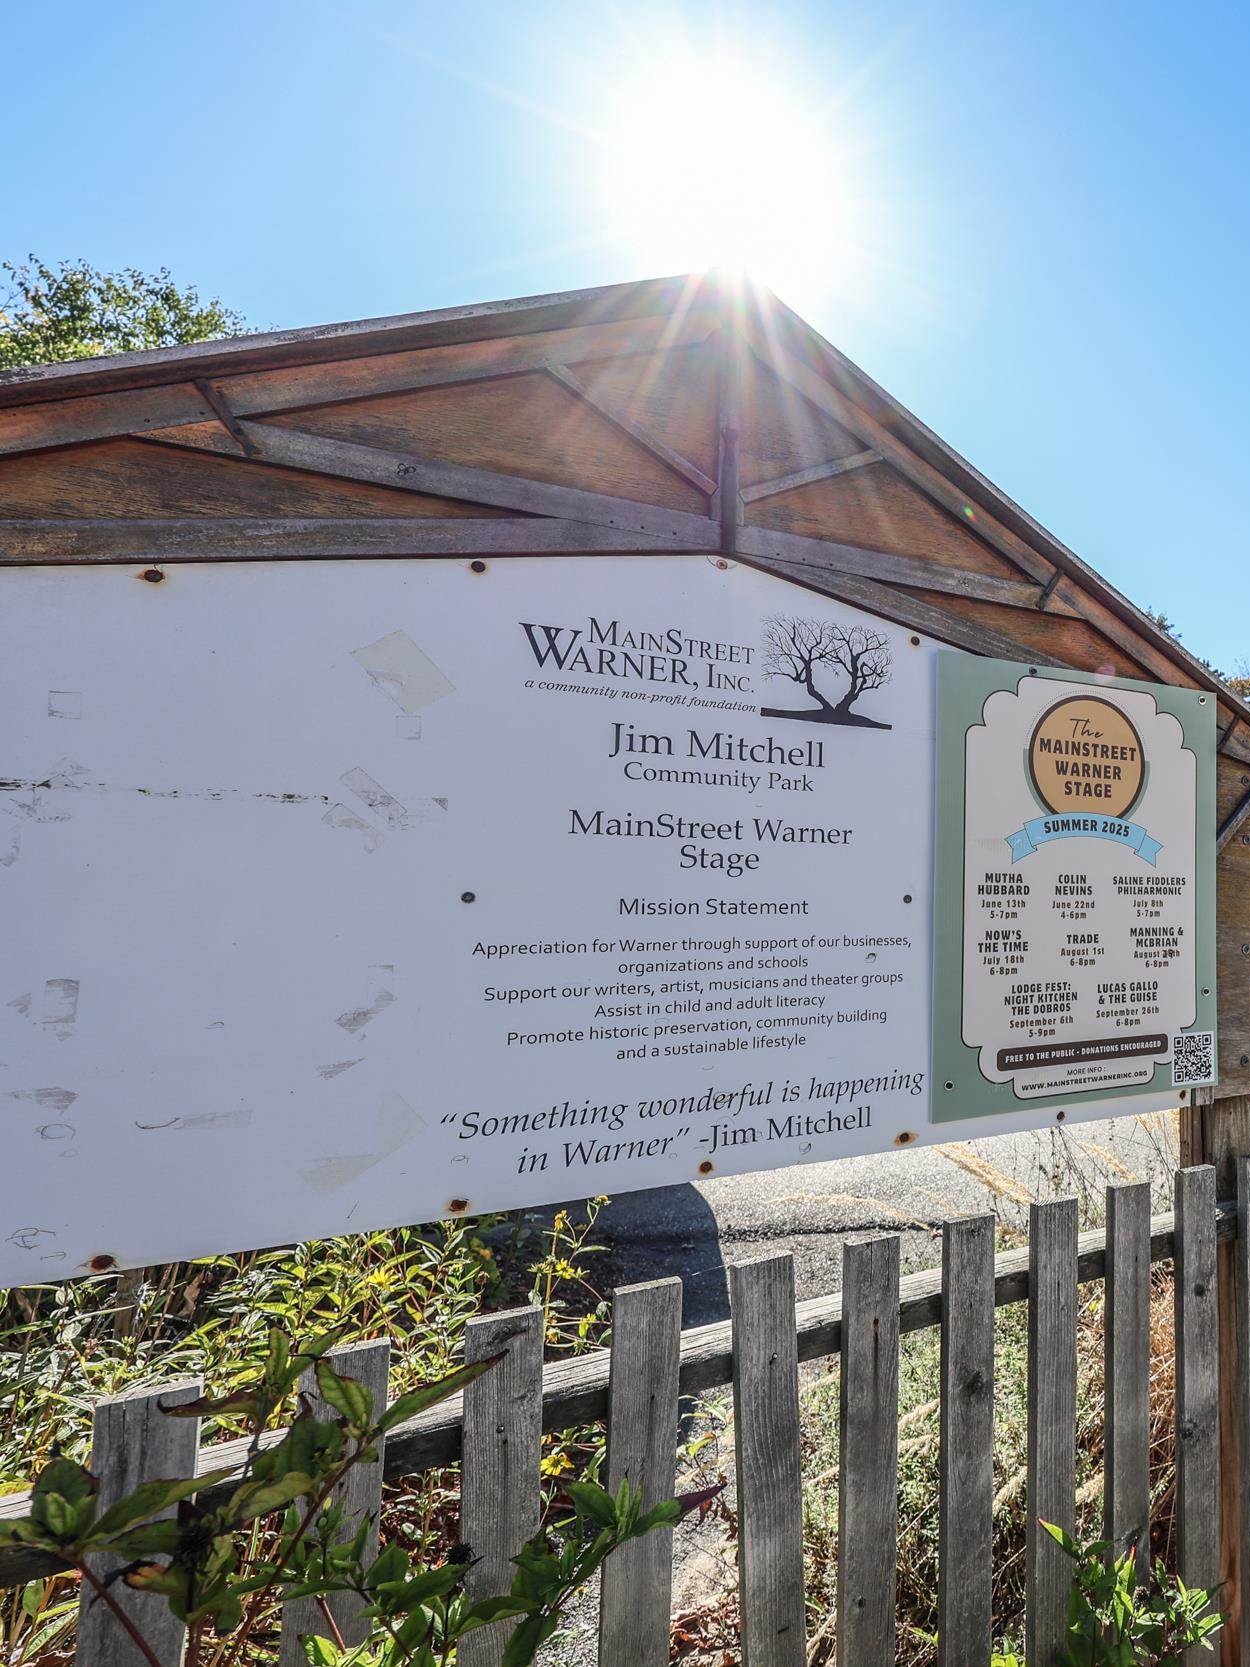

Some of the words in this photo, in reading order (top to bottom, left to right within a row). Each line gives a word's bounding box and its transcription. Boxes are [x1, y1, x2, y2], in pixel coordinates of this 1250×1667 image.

[525, 680, 534, 688] a
[538, 682, 618, 699] community
[622, 691, 686, 705] non-profit
[687, 697, 756, 712] foundation
[1070, 718, 1103, 739] The
[609, 723, 674, 757] Jim
[686, 730, 824, 767] Mitchell
[1039, 738, 1136, 761] MAINSTREET
[1055, 760, 1122, 780] WARNER
[623, 761, 760, 793] Community
[767, 772, 814, 792] Park
[1065, 781, 1111, 798] STAGE
[568, 810, 743, 840] MainStreet
[753, 819, 852, 844] Warner
[1044, 819, 1097, 833] SUMMER
[1102, 821, 1129, 837] 2025
[680, 845, 759, 877] Stage
[986, 873, 1023, 883] MUTHA
[1059, 874, 1086, 884] COLIN
[1113, 876, 1143, 885] SALINE
[1147, 877, 1185, 885] FIDDLERS
[978, 885, 1029, 895] HUBBARD
[1056, 886, 1092, 895] NEVINS
[1118, 886, 1181, 895] PHILHARMONIC
[620, 898, 699, 914] Mission
[706, 899, 808, 914] Statement
[982, 900, 1001, 908] June
[1007, 900, 1025, 908] 13th
[1133, 900, 1148, 908] July
[990, 910, 1018, 919] 5-7pm
[1060, 911, 1087, 919] 4-6pm
[1130, 927, 1174, 936] MANNING
[1178, 927, 1184, 936] &
[1067, 934, 1098, 944] TRADE
[1136, 938, 1177, 947] MCBRIAN
[472, 941, 586, 959] Appreciation
[592, 939, 616, 952] for
[619, 940, 678, 952] Warner
[682, 937, 740, 953] through
[745, 938, 798, 952] support
[802, 936, 816, 948] of
[819, 939, 840, 947] our
[844, 935, 911, 948] businesses,
[978, 942, 998, 952] THE
[1002, 942, 1028, 952] TIME
[1061, 948, 1088, 956] August
[1093, 947, 1104, 955] 1st
[983, 956, 1000, 965] July
[1005, 955, 1024, 964] 18th
[1134, 950, 1160, 959] August
[618, 959, 723, 976] organizations
[728, 956, 753, 969] and
[758, 955, 808, 968] schools
[1070, 958, 1096, 966] 6-8pm
[1145, 960, 1169, 968] 6-8pm
[990, 967, 1018, 975] 6-8pm
[484, 987, 556, 1004] Support
[562, 987, 590, 997] our
[595, 982, 654, 996] writers,
[660, 980, 703, 994] artist,
[710, 977, 778, 990] musicians
[783, 974, 807, 987] and
[811, 974, 858, 986] theater
[862, 974, 903, 987] groups
[1012, 984, 1042, 994] LODGE
[1046, 982, 1070, 992] FEST:
[1098, 983, 1126, 993] LUCAS
[1130, 981, 1158, 991] GALLO
[1005, 995, 1034, 1005] NIGHT
[1038, 992, 1077, 1003] KITCHEN
[1099, 995, 1105, 1004] &
[1109, 994, 1126, 1004] THE
[1130, 992, 1157, 1002] GUISE
[594, 1004, 642, 1018] Assist
[648, 1003, 660, 1014] in
[665, 999, 700, 1013] child
[706, 998, 732, 1011] and
[737, 996, 772, 1009] adult
[777, 995, 825, 1008] literacy
[1012, 1006, 1030, 1015] THE
[1034, 1003, 1070, 1014] DOBROS
[1096, 1008, 1138, 1018] September
[1142, 1006, 1159, 1014] 26th
[507, 1029, 584, 1047] Promote
[589, 1025, 649, 1041] historic
[653, 1018, 751, 1040] preservation,
[755, 1012, 833, 1030] community
[836, 1009, 887, 1024] building
[1010, 1018, 1056, 1028] September
[1060, 1016, 1073, 1024] 6th
[1116, 1018, 1141, 1027] 6-8pm
[1029, 1028, 1056, 1037] 5-9pm
[617, 1045, 646, 1060] and
[652, 1048, 659, 1056] a
[665, 1038, 748, 1056] sustainable
[753, 1034, 806, 1049] lifestyle
[1005, 1055, 1024, 1063] FREE
[1051, 1050, 1075, 1058] PUBLIC
[1081, 1045, 1119, 1056] DONATIONS
[1121, 1041, 1161, 1051] ENCOURAGED
[1067, 1068, 1086, 1076] MORE
[1022, 1071, 1148, 1091] WWW.MAINSTREETWARNERINC.ORG
[638, 1081, 773, 1121] wonderful
[781, 1081, 800, 1103] is
[807, 1069, 925, 1103] happening
[517, 1149, 548, 1175] in
[766, 1106, 872, 1140] Mitchell
